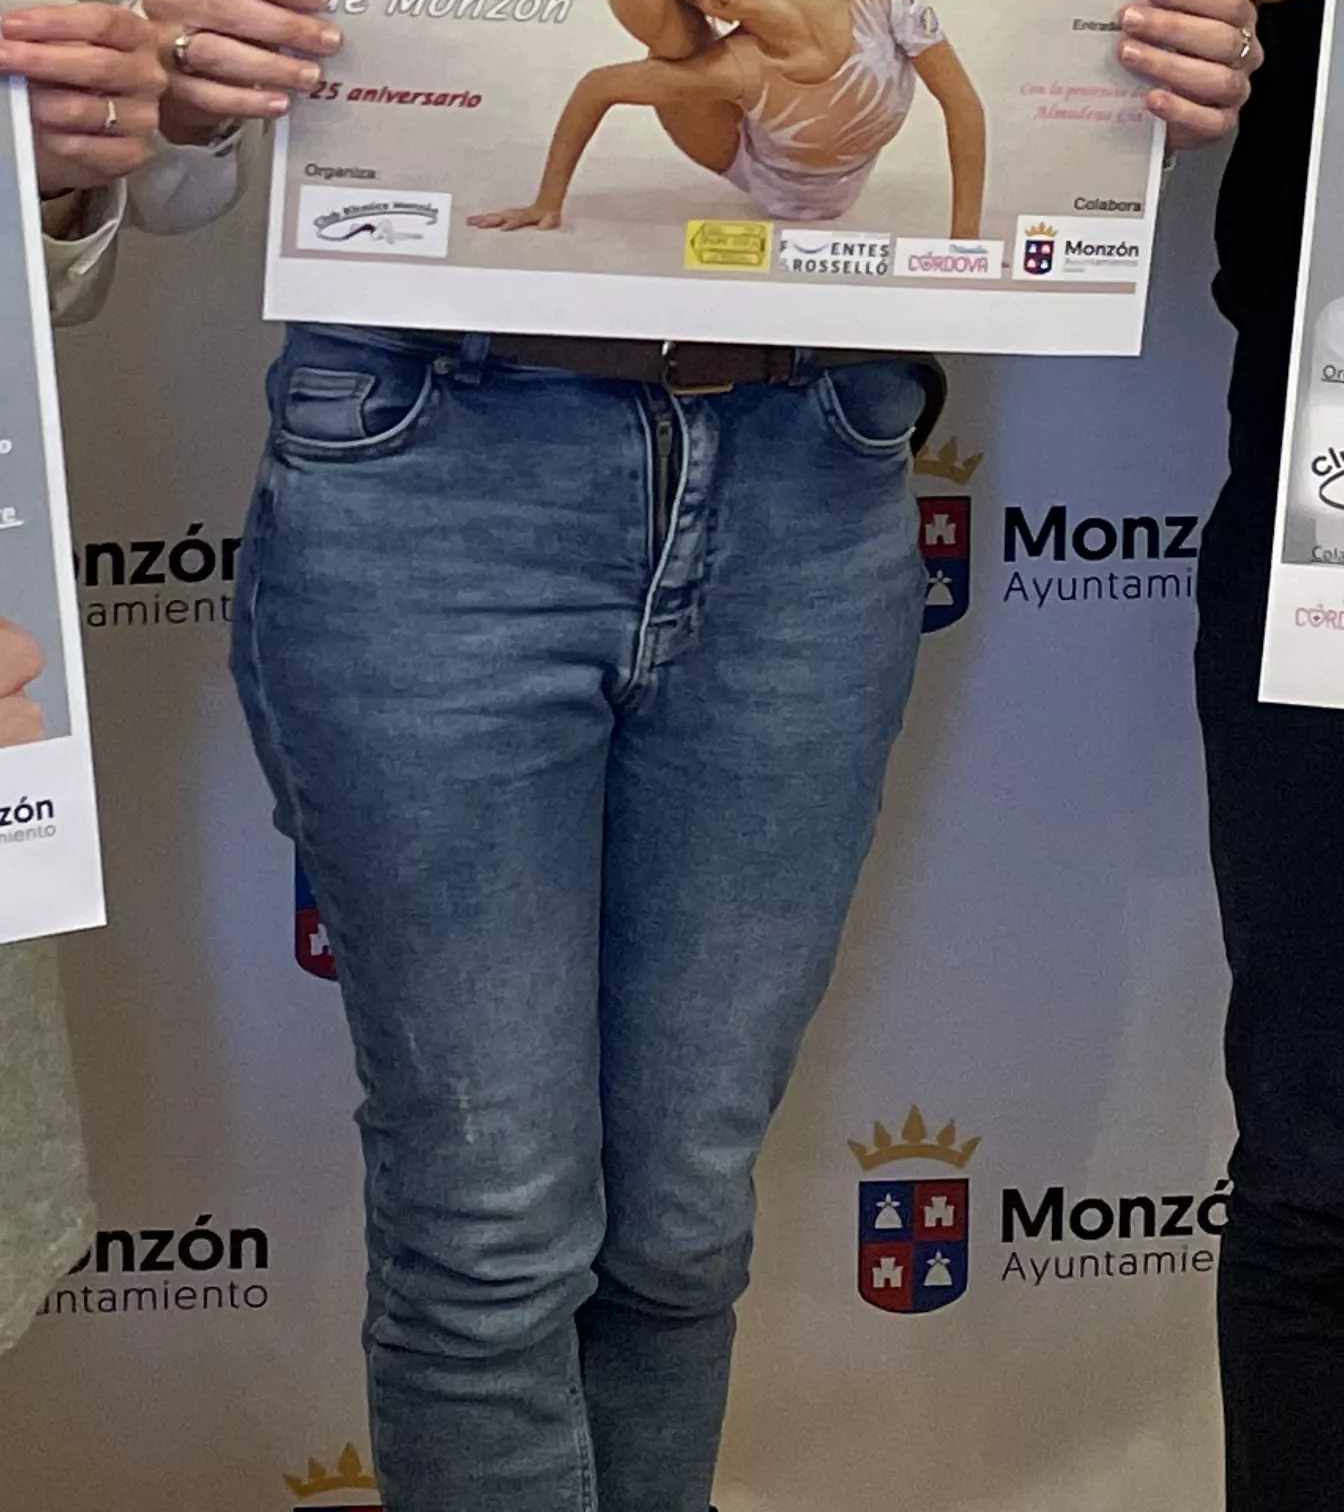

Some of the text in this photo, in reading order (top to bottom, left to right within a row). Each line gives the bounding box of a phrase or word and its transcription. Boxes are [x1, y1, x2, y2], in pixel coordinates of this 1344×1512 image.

[309, 81, 483, 109] 25 aniversario
[1064, 240, 1140, 258] Monzón
[72, 522, 244, 587] nzó
[1004, 505, 1199, 562] Monz
[1003, 567, 1193, 608] Ayuntami
[1001, 1180, 1235, 1243] Monzó
[1001, 1244, 1214, 1286] Ayuntamie
